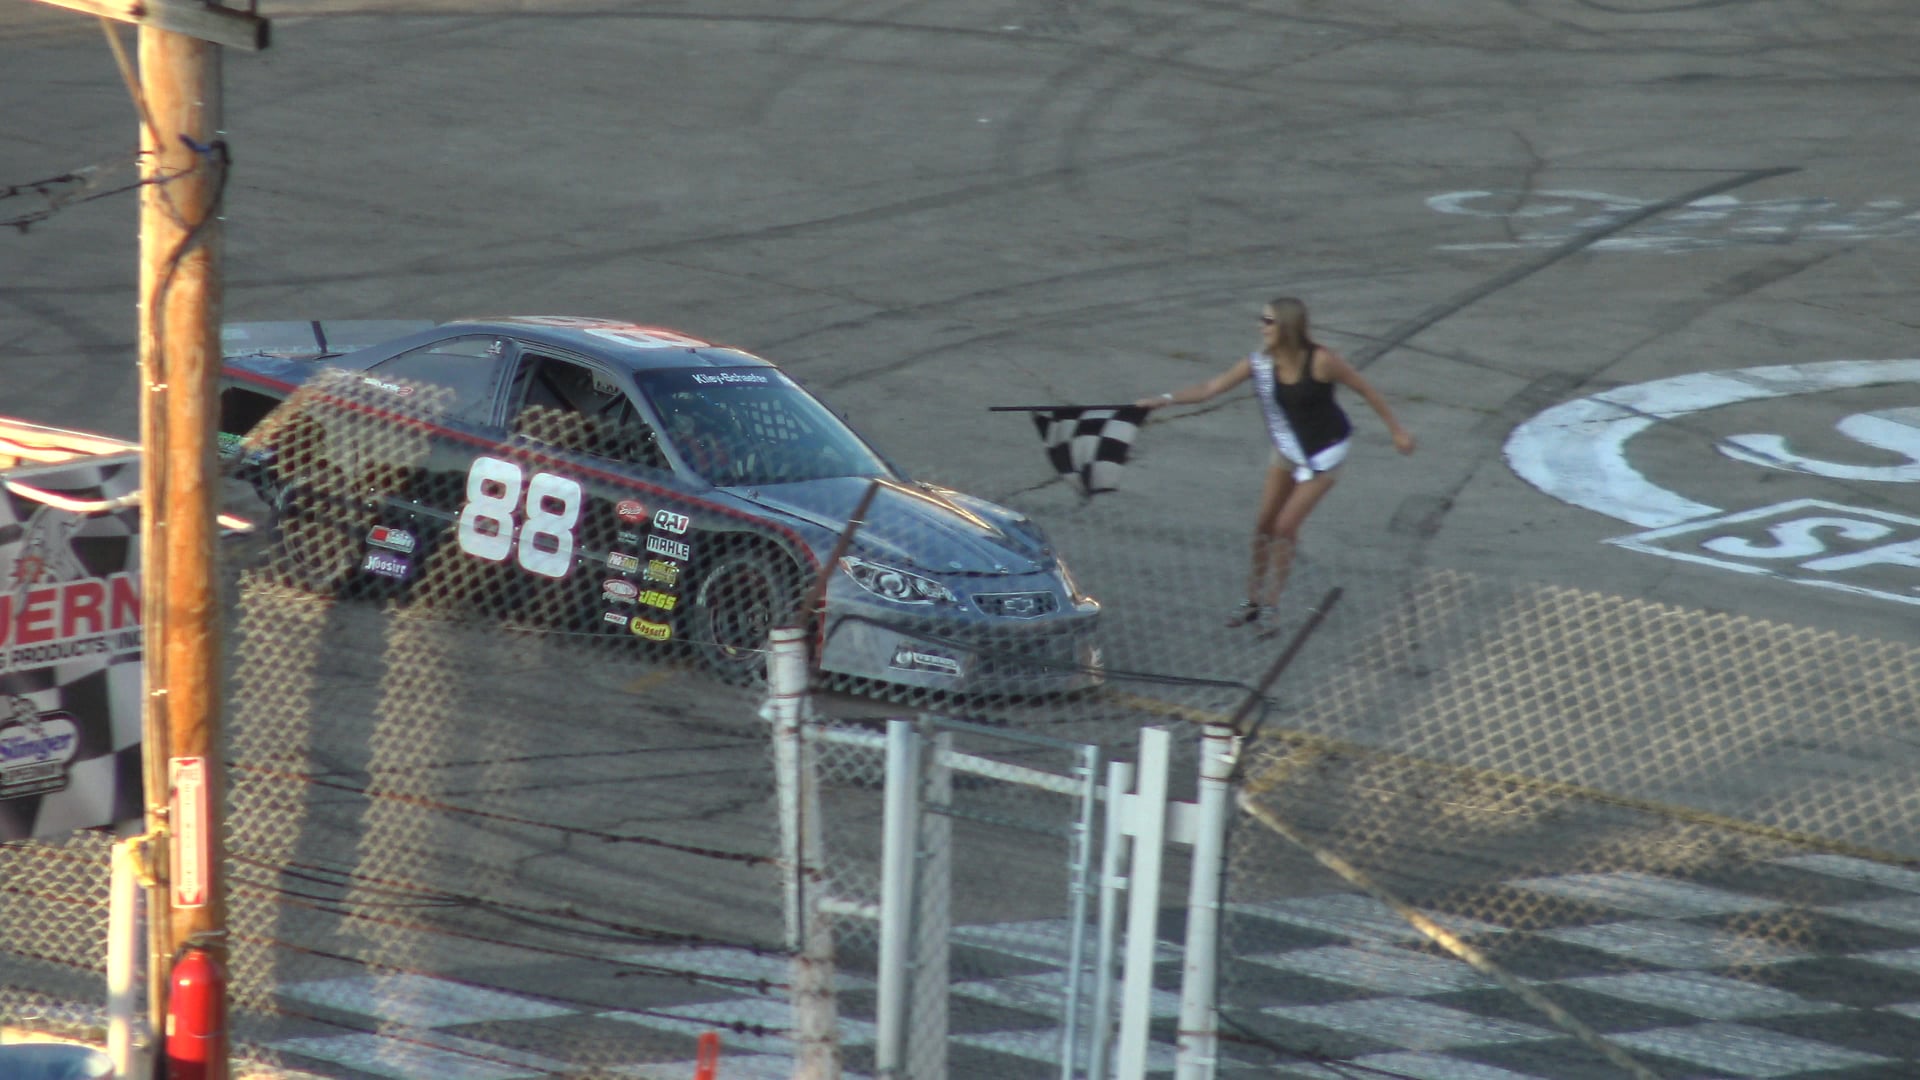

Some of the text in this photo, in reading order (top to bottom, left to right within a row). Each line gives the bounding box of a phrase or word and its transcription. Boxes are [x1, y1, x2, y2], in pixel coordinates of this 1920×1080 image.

[458, 456, 582, 578] 88
[656, 509, 689, 531] QA1
[647, 537, 689, 558] MAHLE
[364, 556, 407, 575] Hoosier
[639, 590, 677, 610] JEGS
